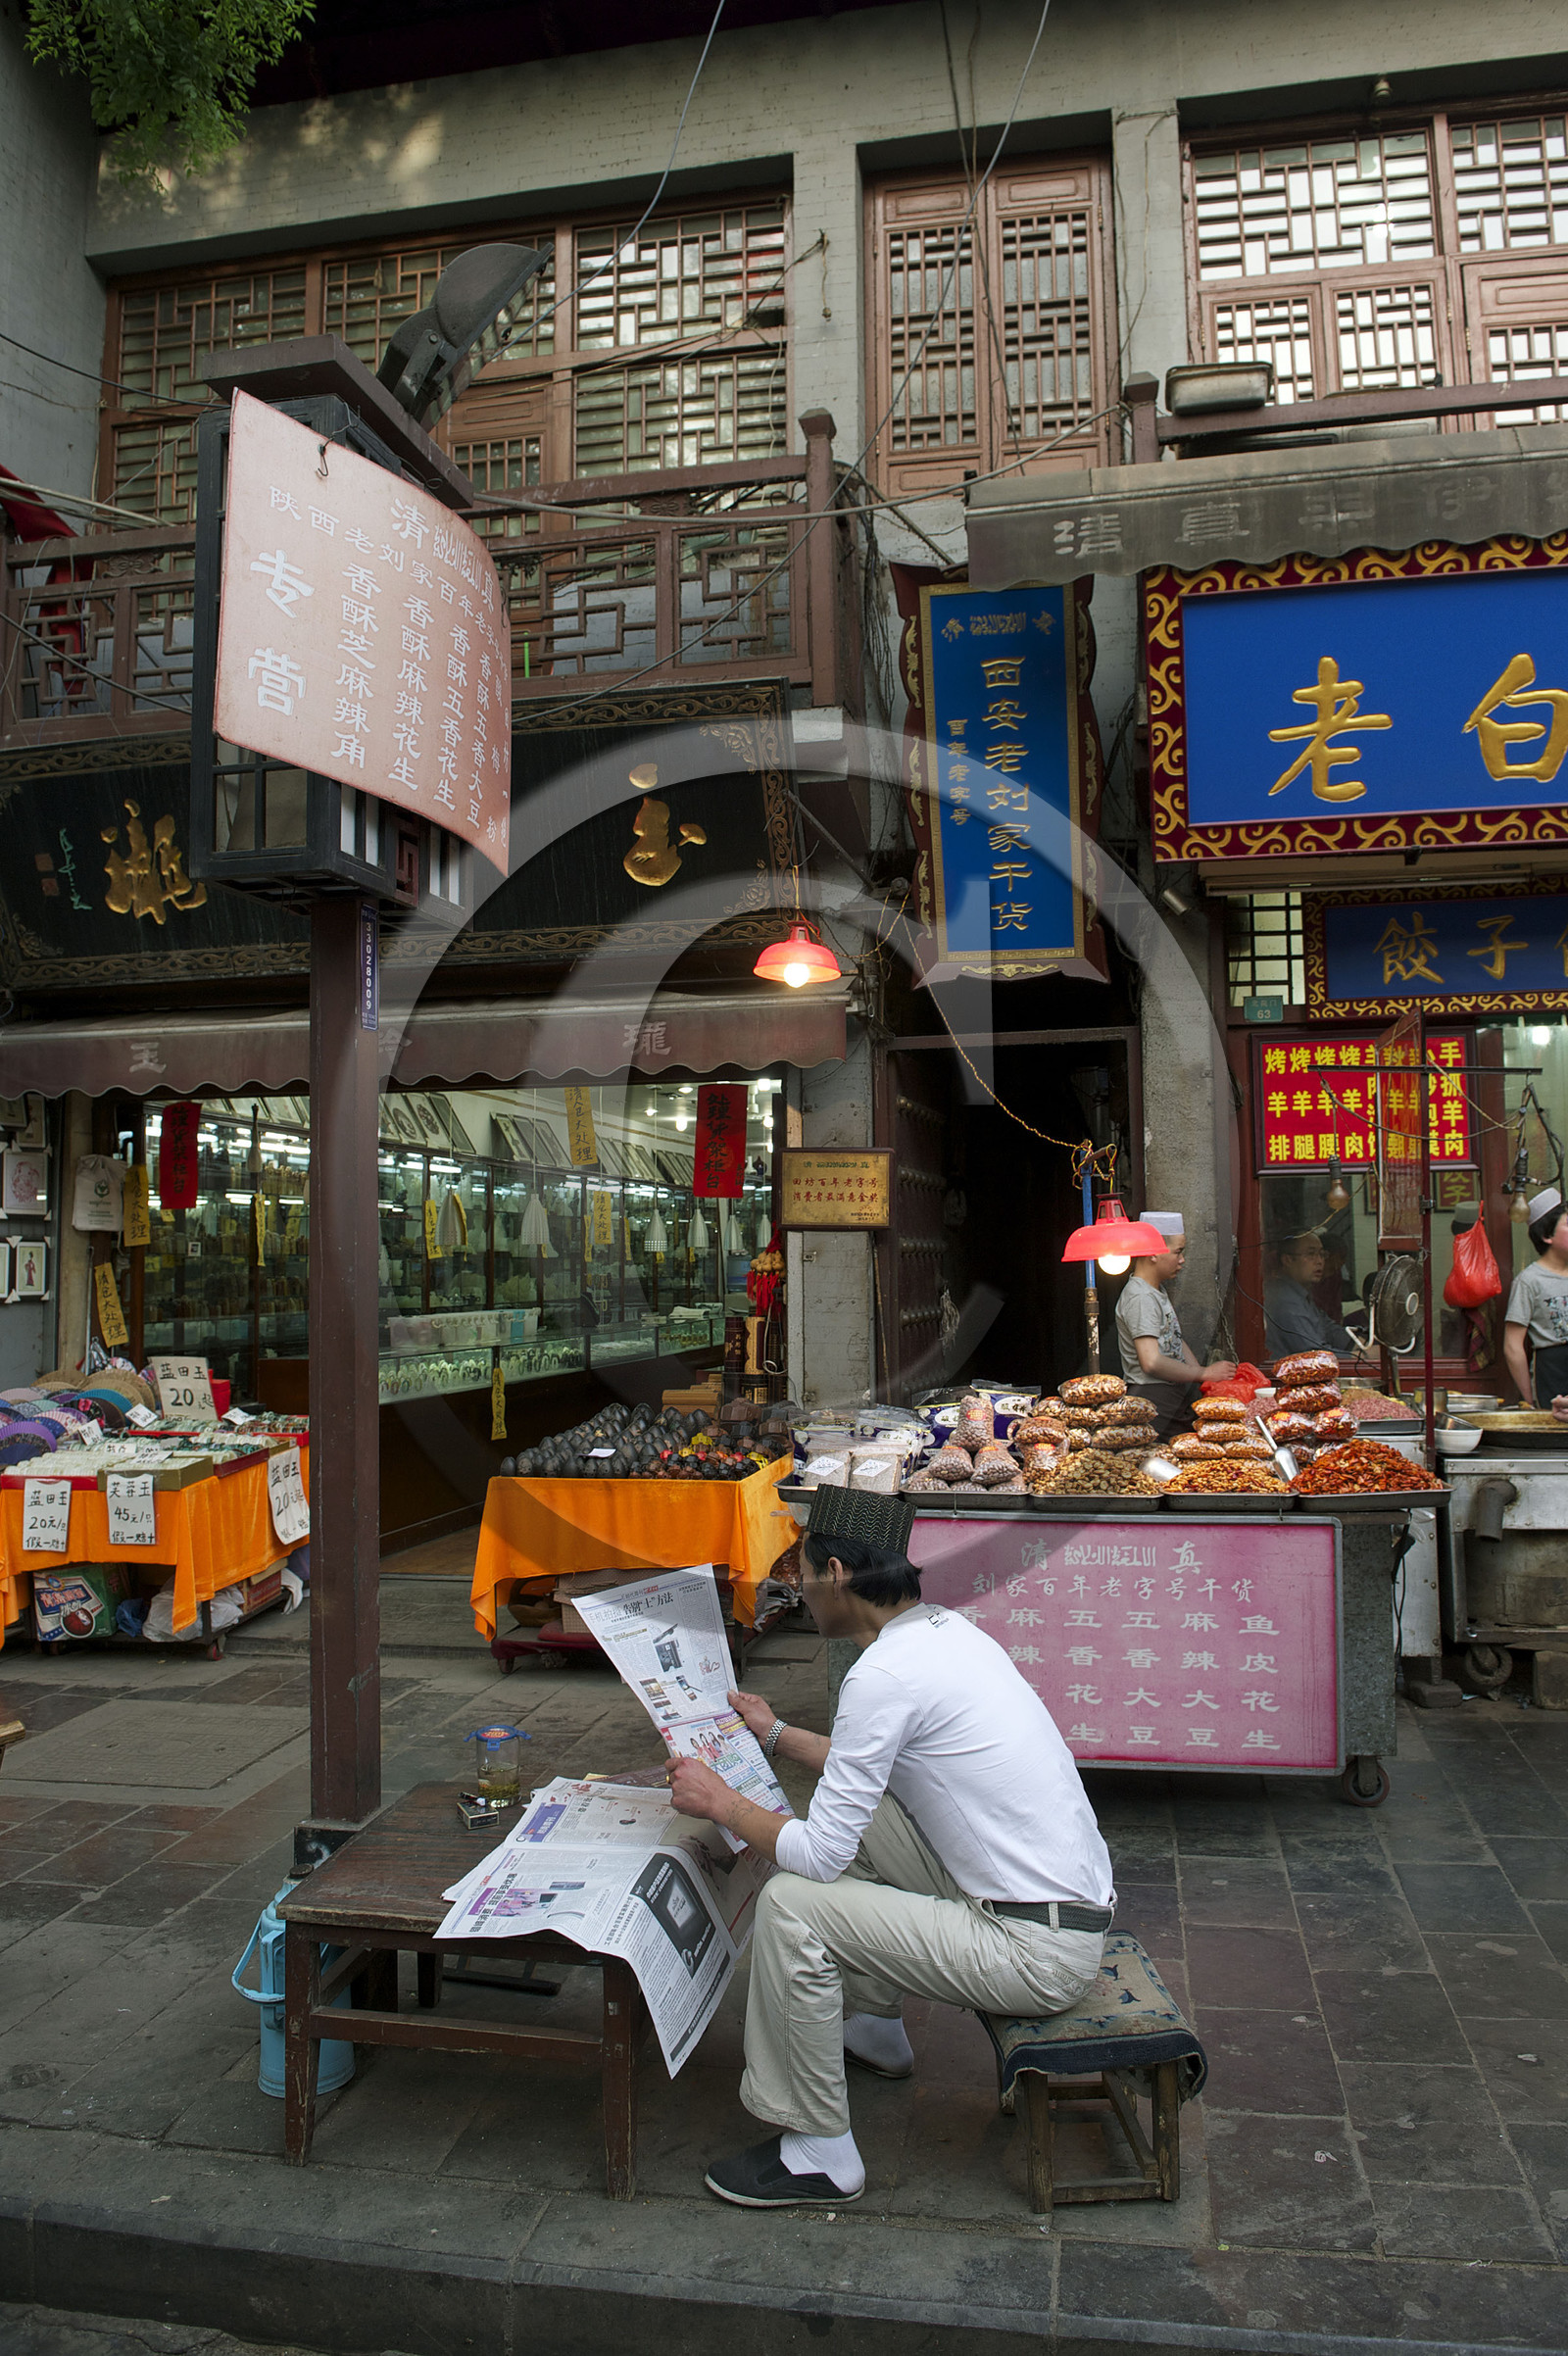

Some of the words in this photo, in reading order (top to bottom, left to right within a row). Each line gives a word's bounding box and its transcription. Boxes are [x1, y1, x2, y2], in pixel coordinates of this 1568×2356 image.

[391, 498, 429, 550] 清
[248, 549, 315, 717] 专营
[330, 562, 381, 769] 香酥芝麻辣角
[388, 594, 434, 792] 香酥麻辣花生
[433, 623, 470, 811] 香酥五香花生
[466, 651, 492, 829] 香酥五香大豆
[1268, 653, 1568, 804] 老白
[947, 718, 971, 826] 百年老字号
[980, 656, 1033, 931] 西安老刘家干货
[1256, 1009, 1272, 1019] 63
[1264, 1048, 1291, 1161] 烤羊排
[1290, 1047, 1315, 1160] 烤羊腿
[1339, 1044, 1364, 1159] 烤羊肉
[159, 1362, 208, 1381] 蓝田玉
[970, 1572, 1255, 1604] 刘家百年老字号干货
[1021, 1538, 1053, 1571] 清
[1168, 1541, 1203, 1575] 真
